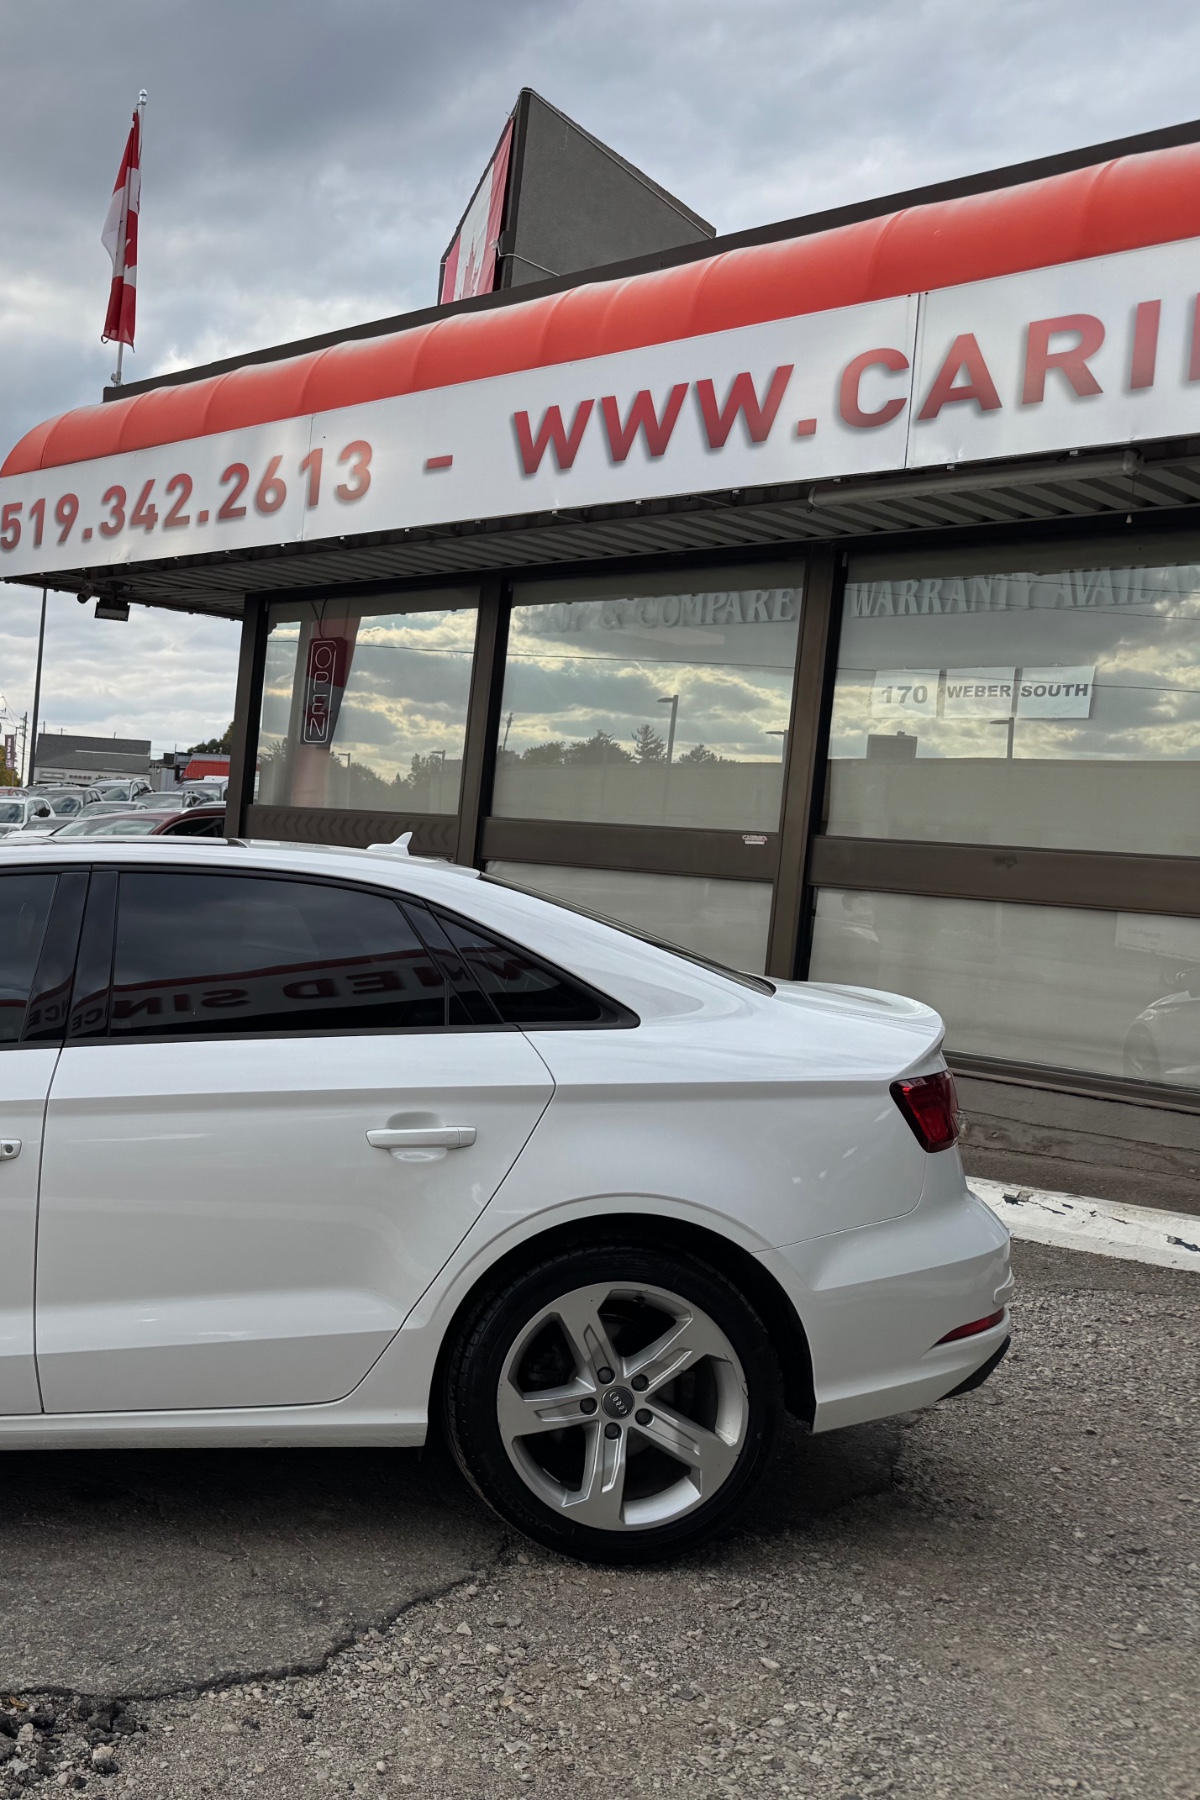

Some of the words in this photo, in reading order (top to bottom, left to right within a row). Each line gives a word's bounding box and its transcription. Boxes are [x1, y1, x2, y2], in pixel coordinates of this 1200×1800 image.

[0, 439, 373, 550] 519.342.2613
[513, 290, 1200, 475] WWW.CARI
[850, 573, 1036, 617] WARRANTY
[309, 647, 332, 737] OPEN
[881, 685, 928, 704] 170
[946, 684, 1012, 698] WEBER
[1020, 683, 1089, 698] SOUTH
